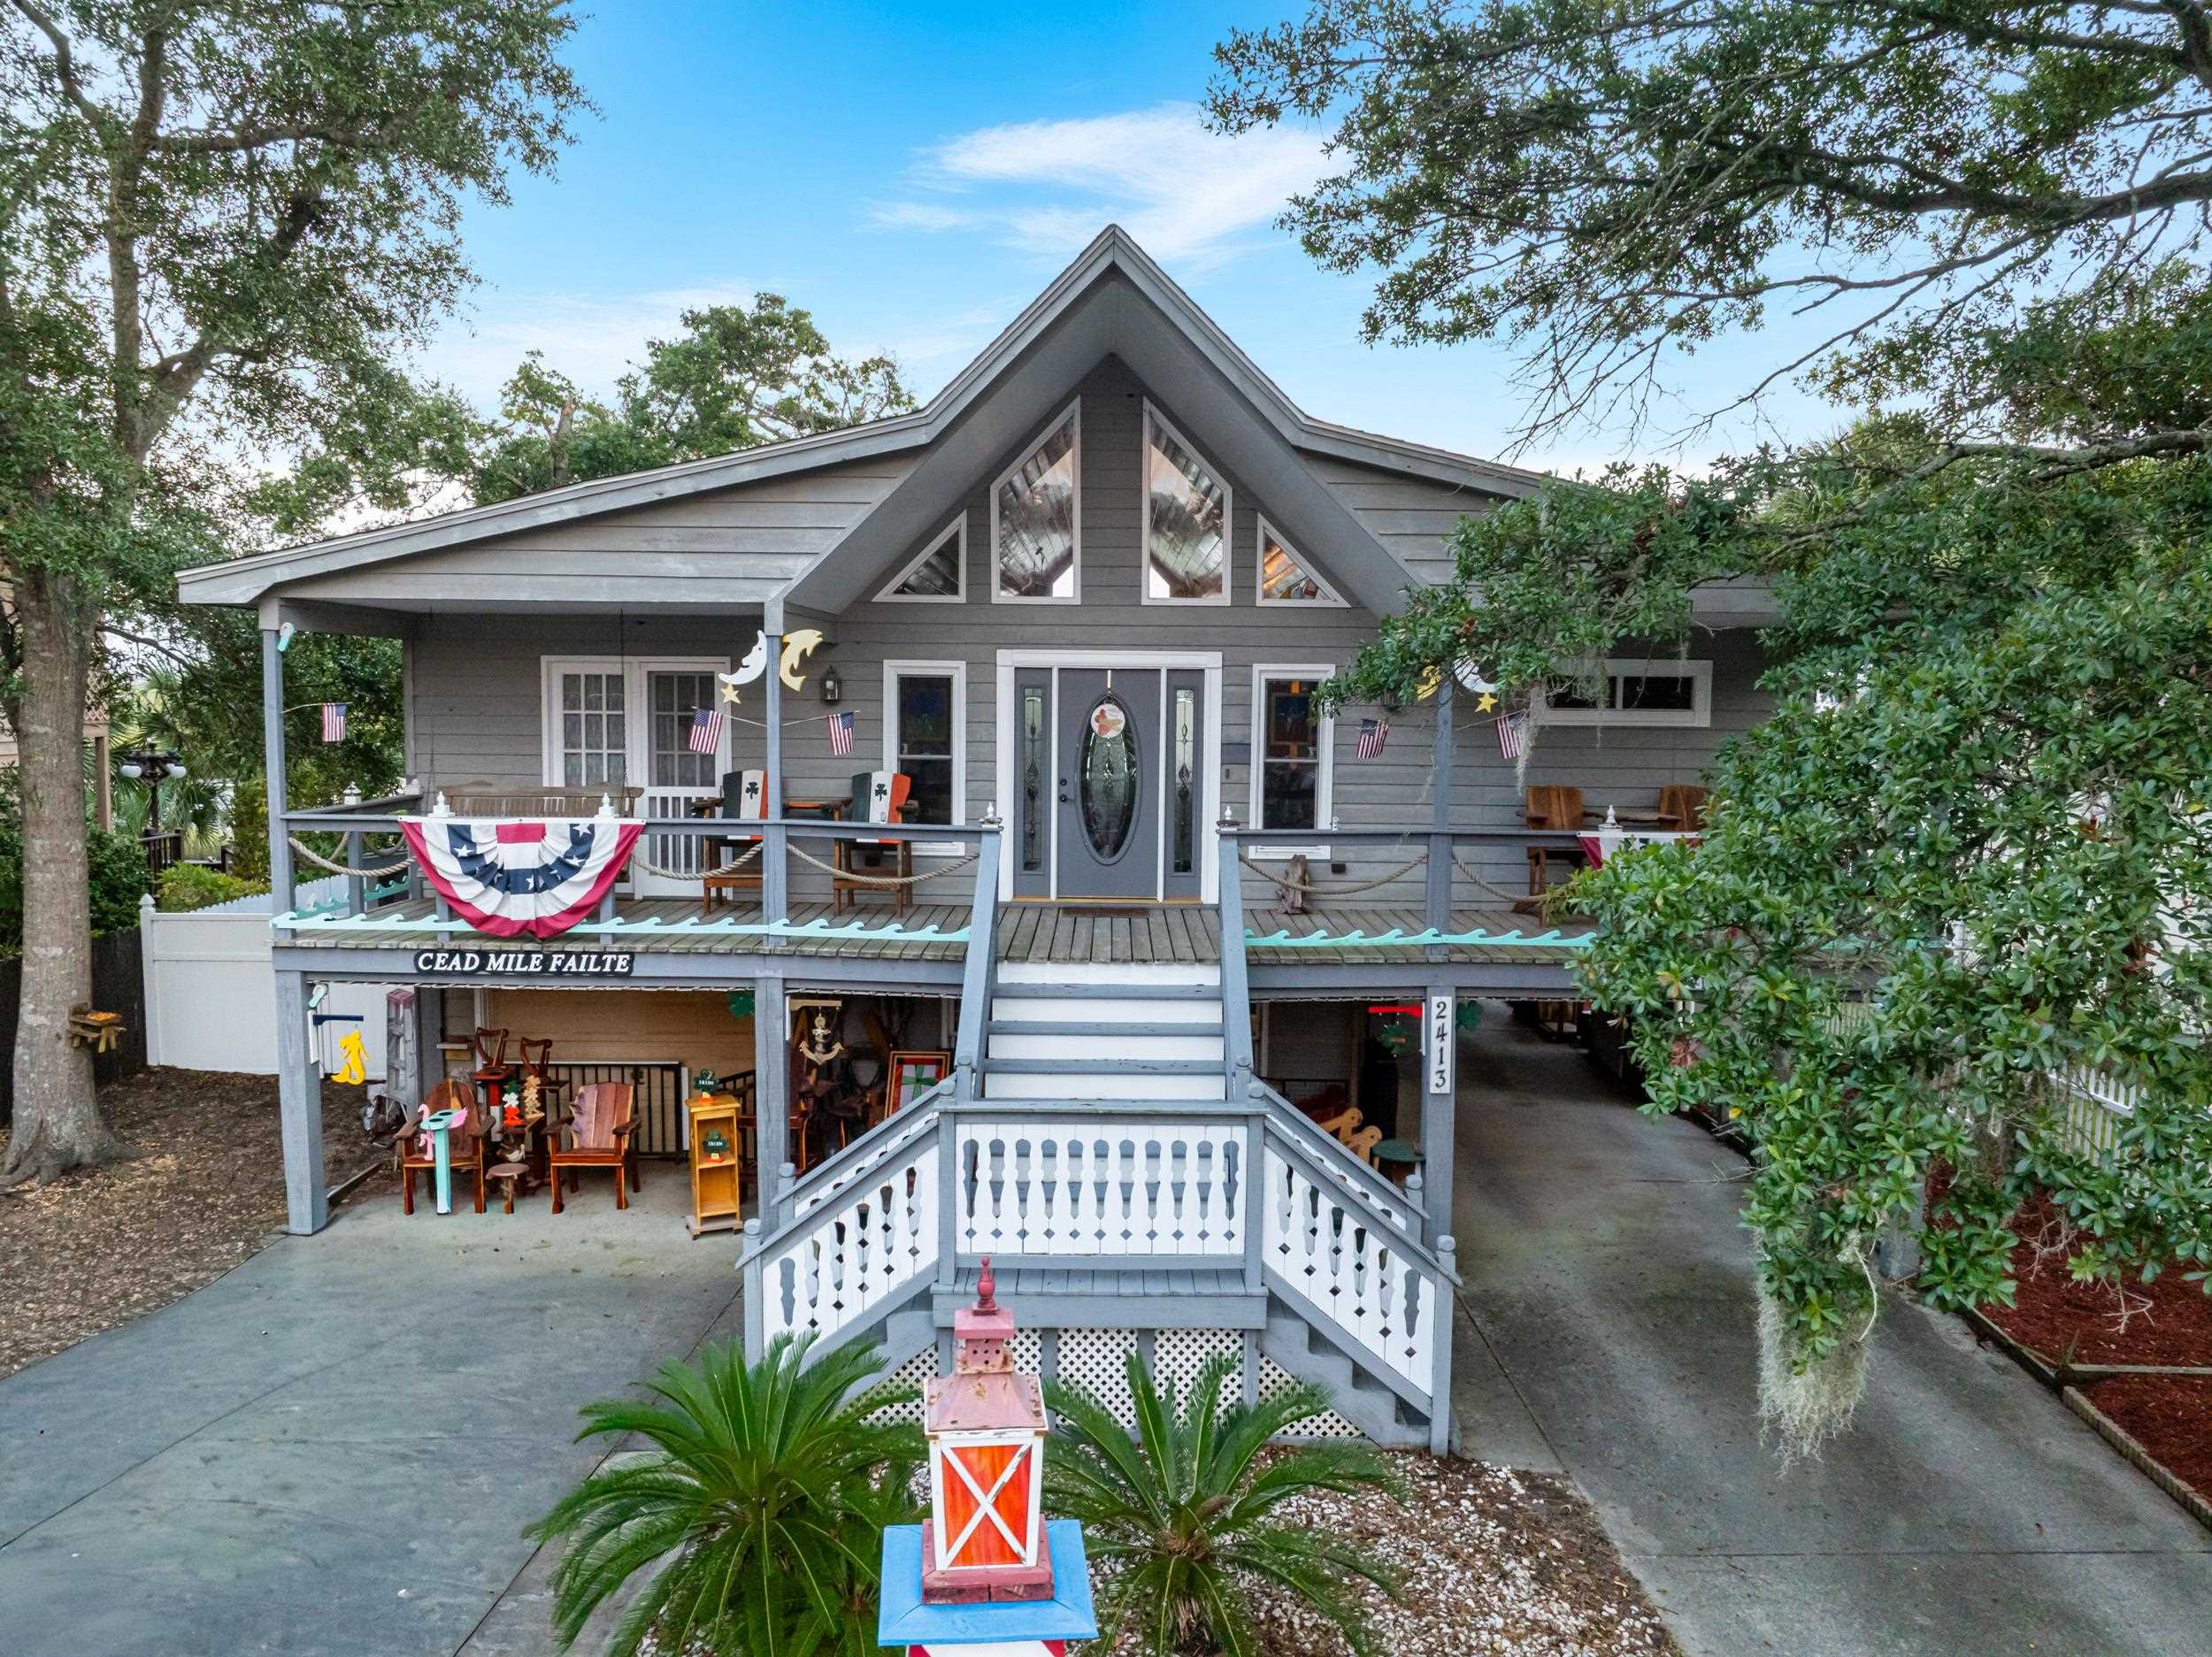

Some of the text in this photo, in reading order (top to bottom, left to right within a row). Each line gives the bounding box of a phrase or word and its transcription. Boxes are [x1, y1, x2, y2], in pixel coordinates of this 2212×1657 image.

[418, 953, 630, 972] CEAD MILE FAILTE
[1435, 1001, 1448, 1088] 2413
